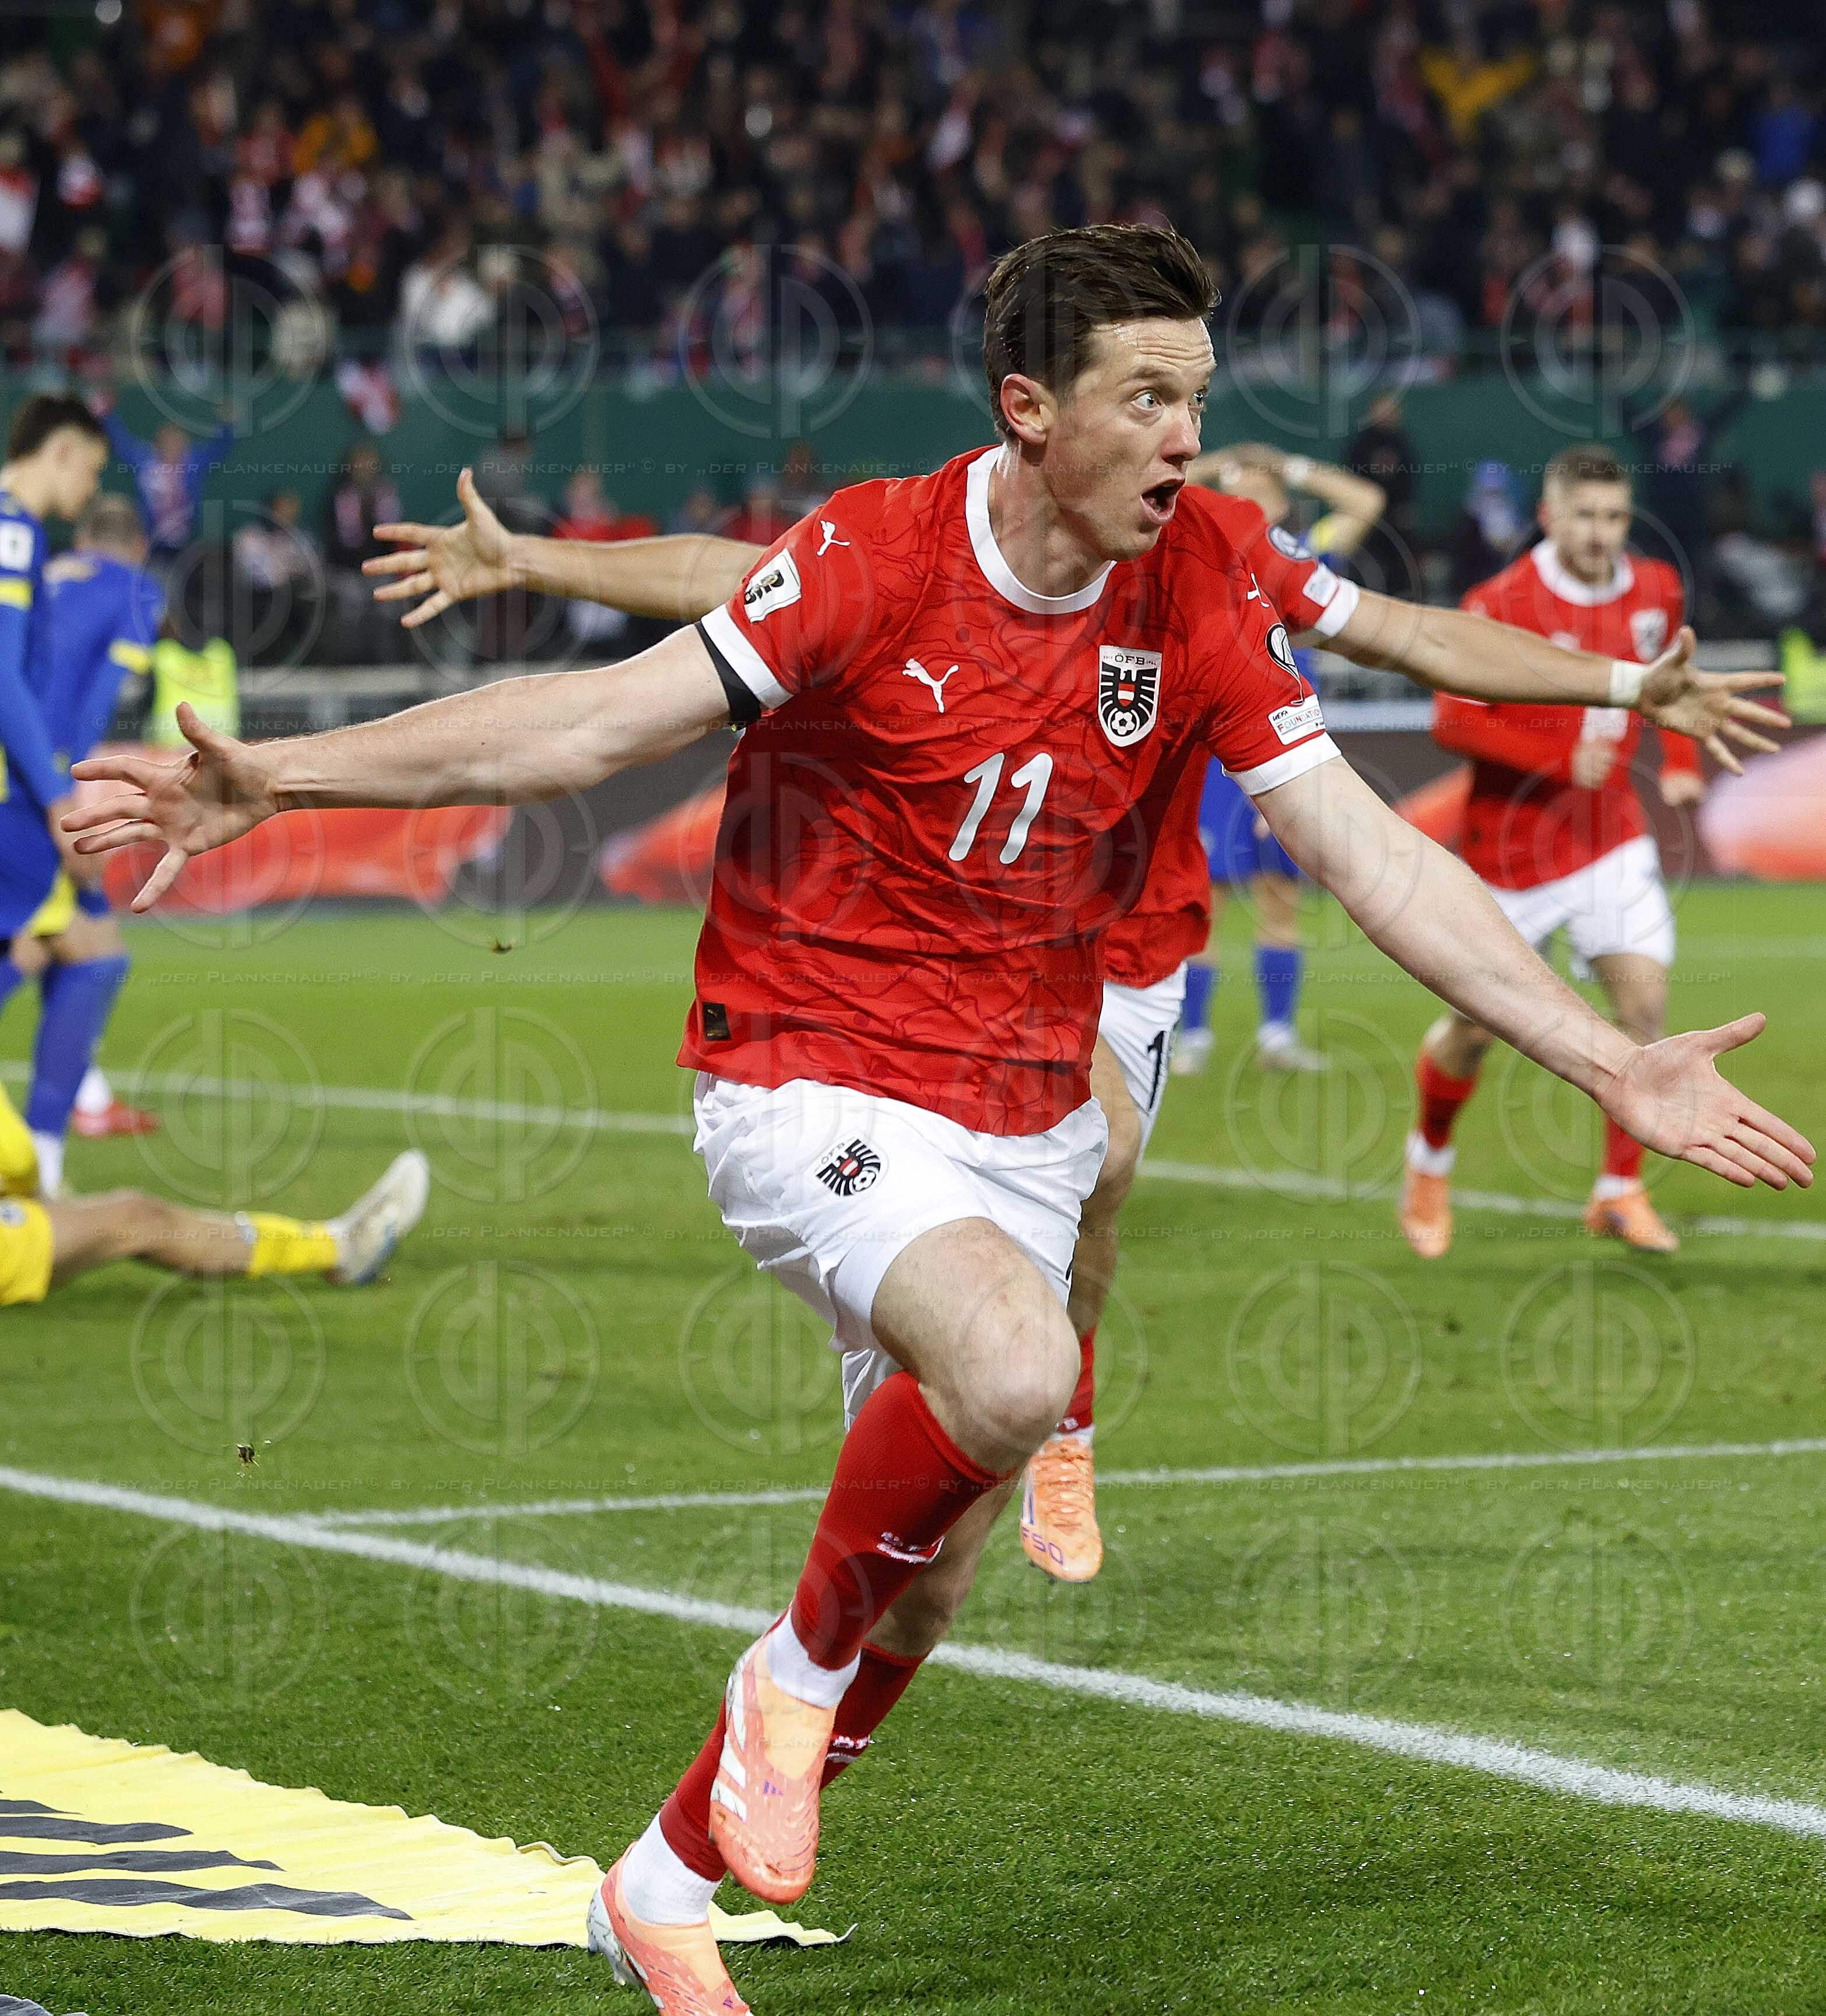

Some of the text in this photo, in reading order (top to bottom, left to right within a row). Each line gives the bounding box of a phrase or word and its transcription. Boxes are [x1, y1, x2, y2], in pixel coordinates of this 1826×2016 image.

[1114, 653, 1145, 666] ÖFB
[1277, 708, 1321, 733] FOUNDATIO
[948, 752, 1054, 865] 11
